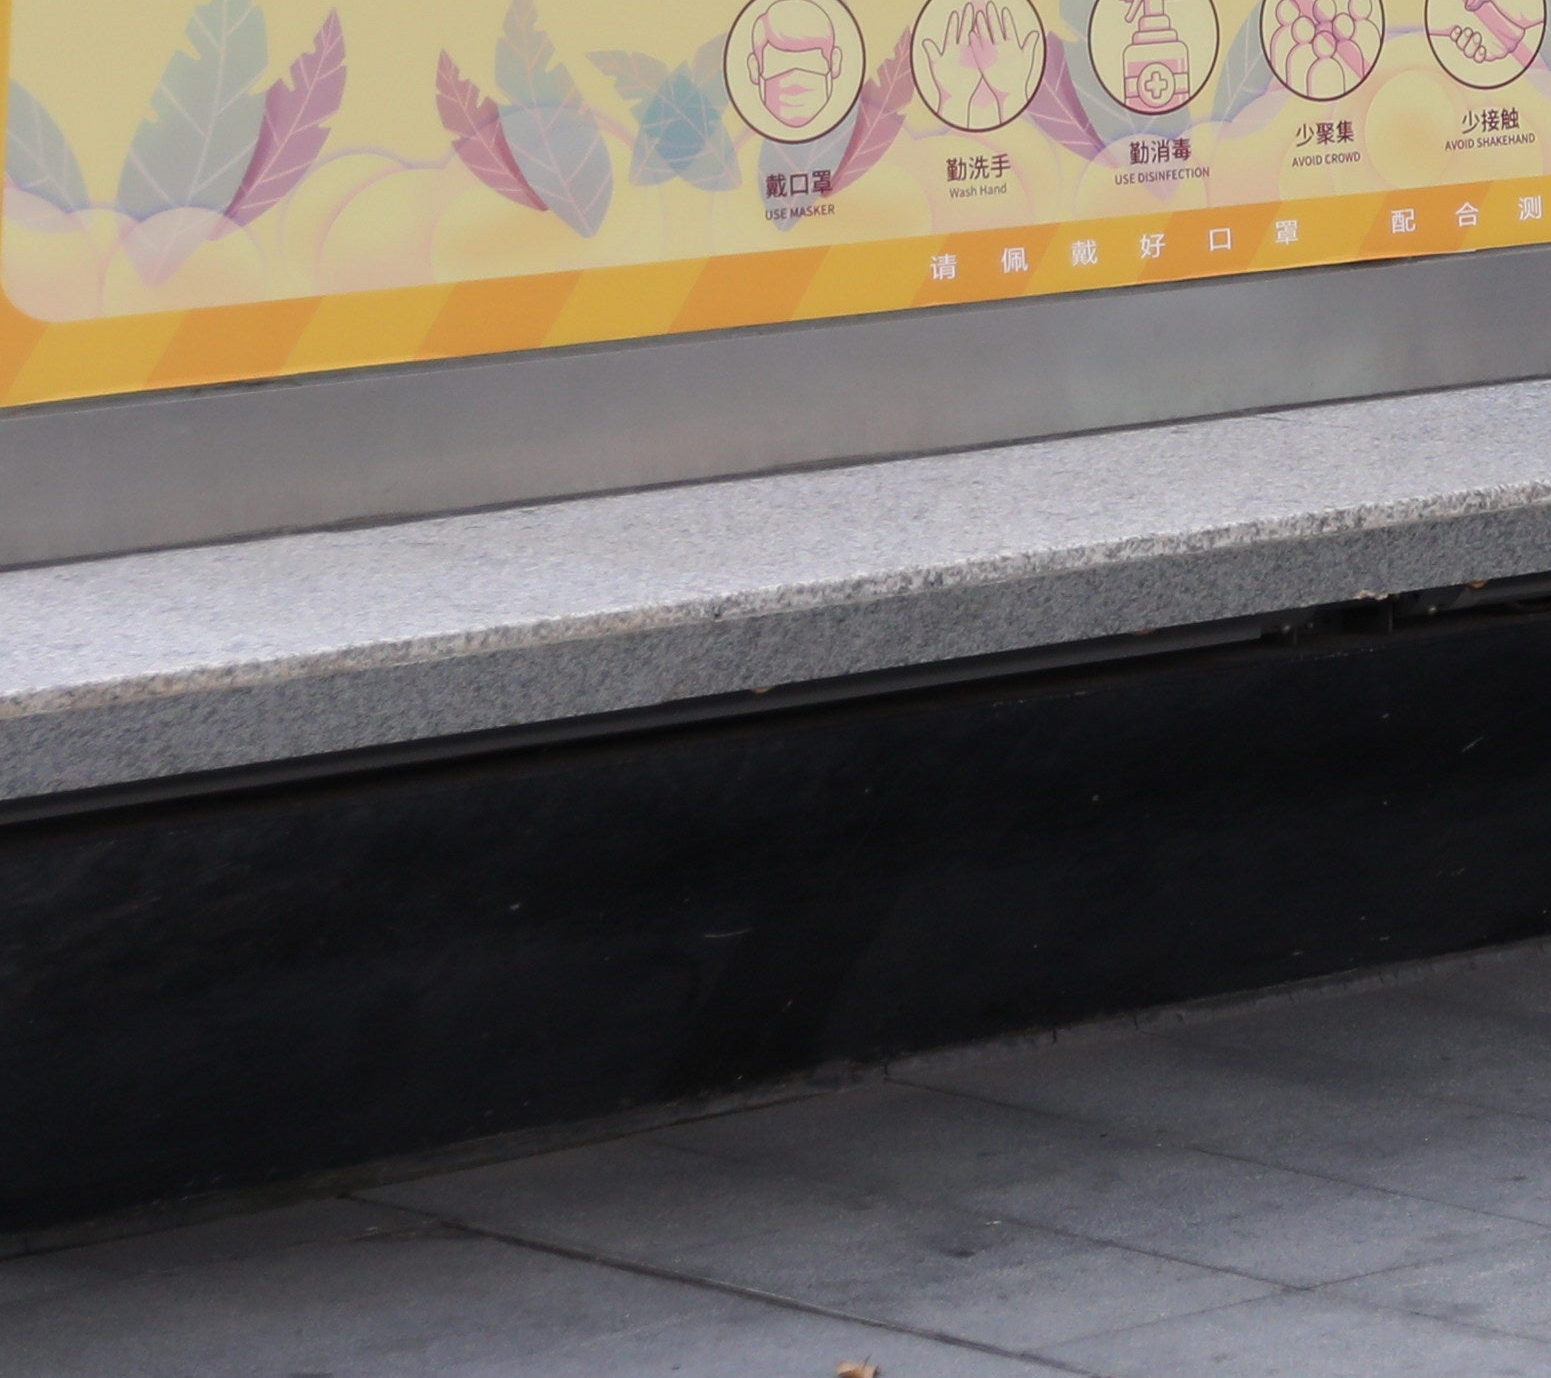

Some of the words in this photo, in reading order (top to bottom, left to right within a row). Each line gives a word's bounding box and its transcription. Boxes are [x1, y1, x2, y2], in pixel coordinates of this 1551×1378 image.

[1294, 119, 1355, 149] 少聚集
[1460, 107, 1520, 135] 少接触
[1129, 136, 1192, 167] 勤消毒
[1444, 137, 1475, 152] AVOID
[1476, 131, 1537, 150] SHAKEHAND
[945, 152, 1012, 183] 勤洗手
[1291, 154, 1322, 169] AVOID
[1324, 150, 1361, 166] CROWD
[764, 168, 834, 199] 戴口罩
[1114, 171, 1135, 186] USE
[1137, 166, 1211, 185] DISINFECTION
[948, 185, 977, 200] Wash
[978, 182, 1008, 197] Hand
[764, 208, 787, 222] USE
[789, 202, 836, 220] MASKER
[928, 218, 1300, 282] 请佩戴好口罩
